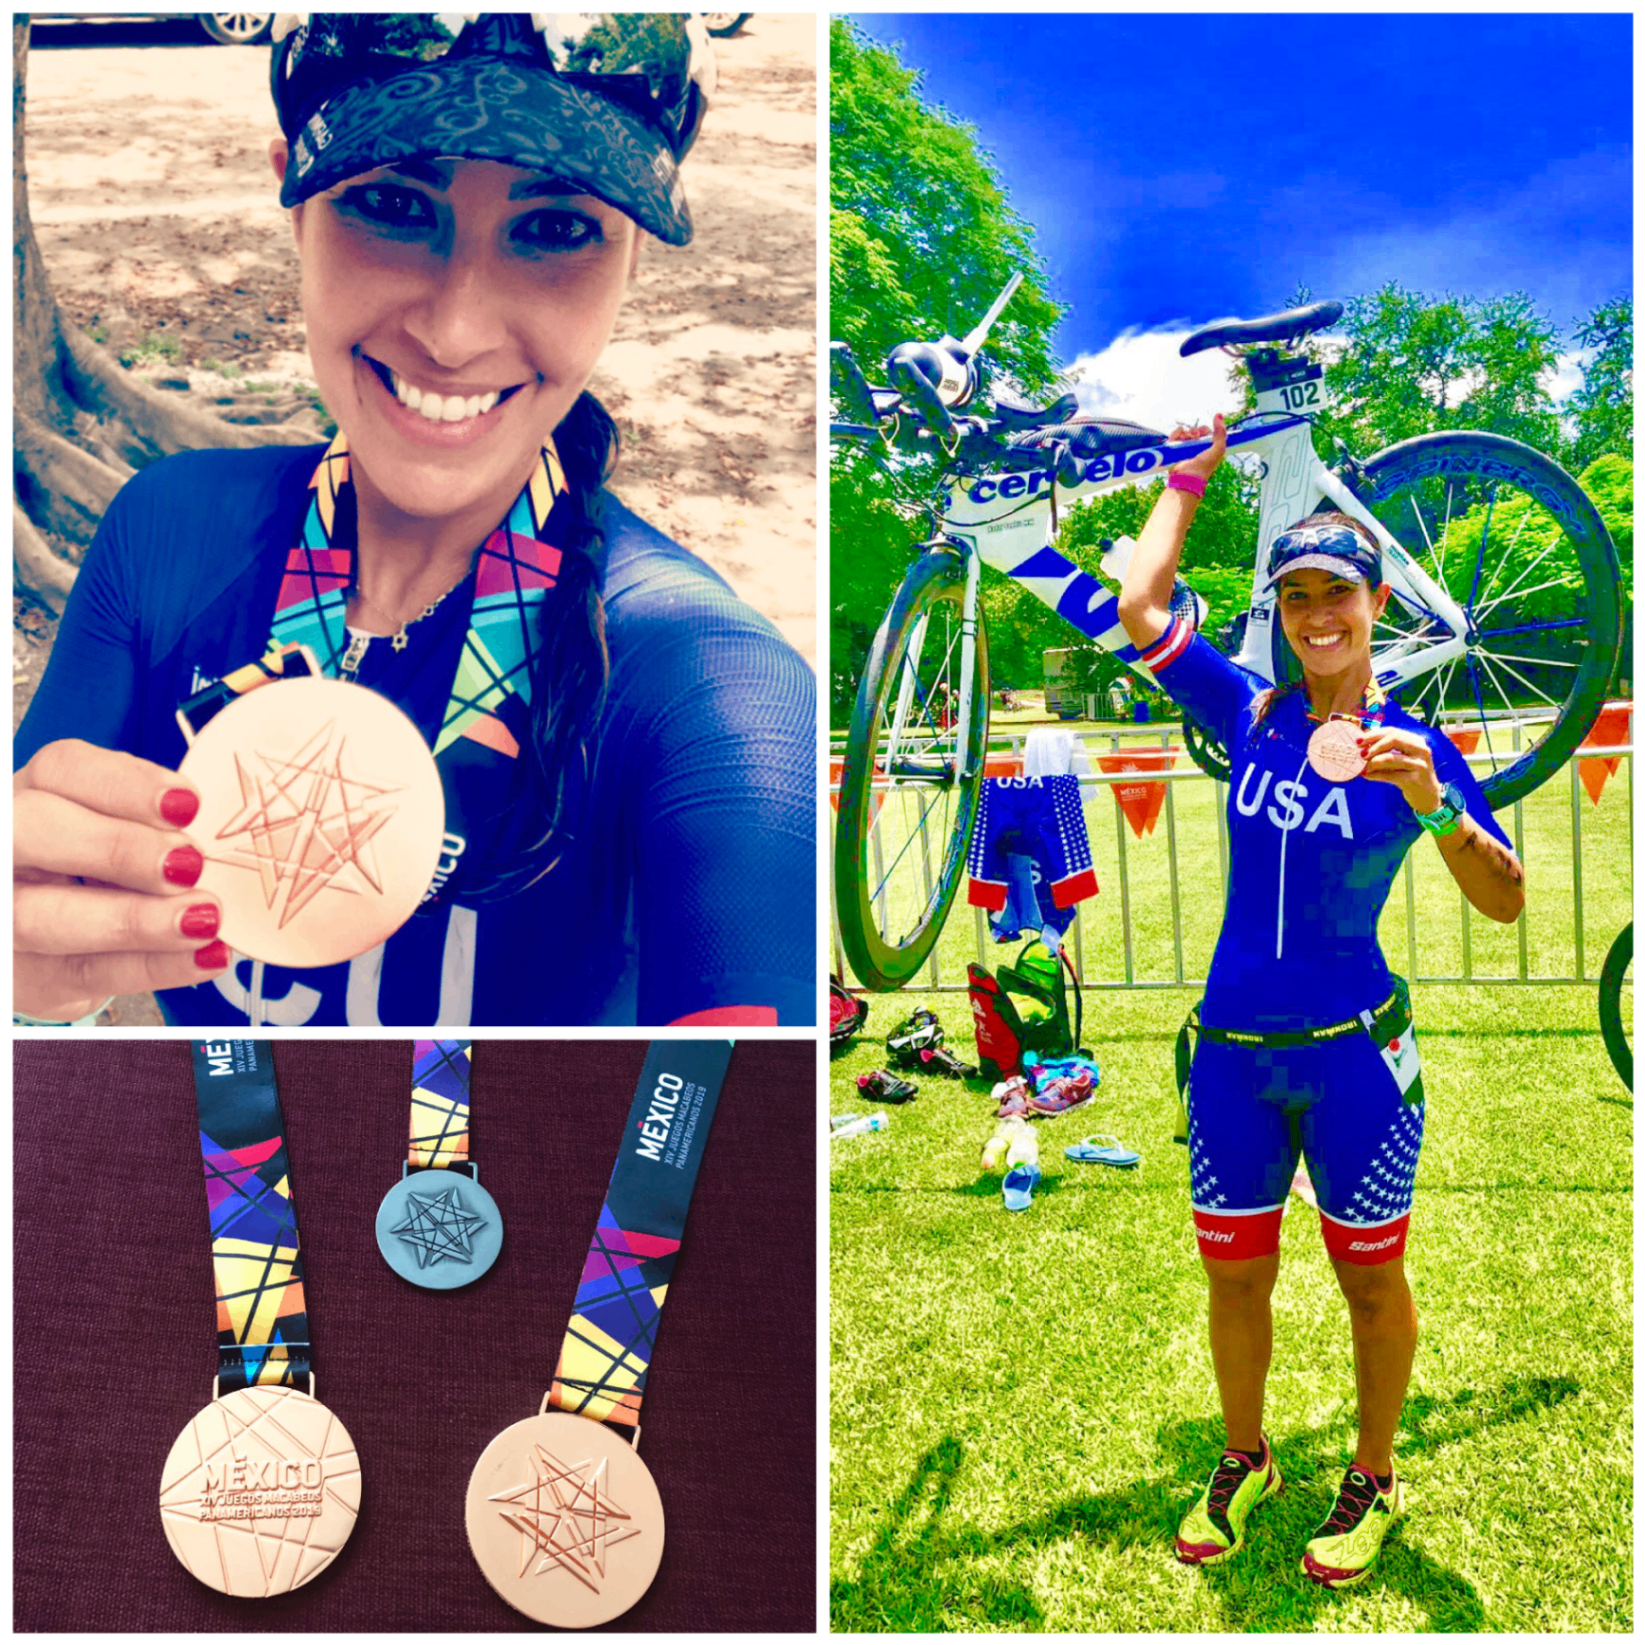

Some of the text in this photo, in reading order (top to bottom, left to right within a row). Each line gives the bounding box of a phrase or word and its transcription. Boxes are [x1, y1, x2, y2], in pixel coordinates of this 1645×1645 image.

[1280, 382, 1320, 410] 102
[968, 451, 1157, 504] cerelo
[1374, 456, 1586, 534] SPINERGY
[997, 776, 1044, 789] USA
[1236, 762, 1354, 839] USA
[1313, 1020, 1357, 1038] IRONMAN
[636, 1073, 683, 1161] MÉXICO
[664, 1082, 695, 1165] XIV JUEGOS MACABEOS
[675, 1086, 707, 1170] PANAMERICANOS 2019
[200, 1454, 323, 1493] MÉXICO
[199, 1505, 323, 1523] PANAMERICANOS 2019
[200, 1491, 323, 1508] XIV JUEGOS MACABEOS
